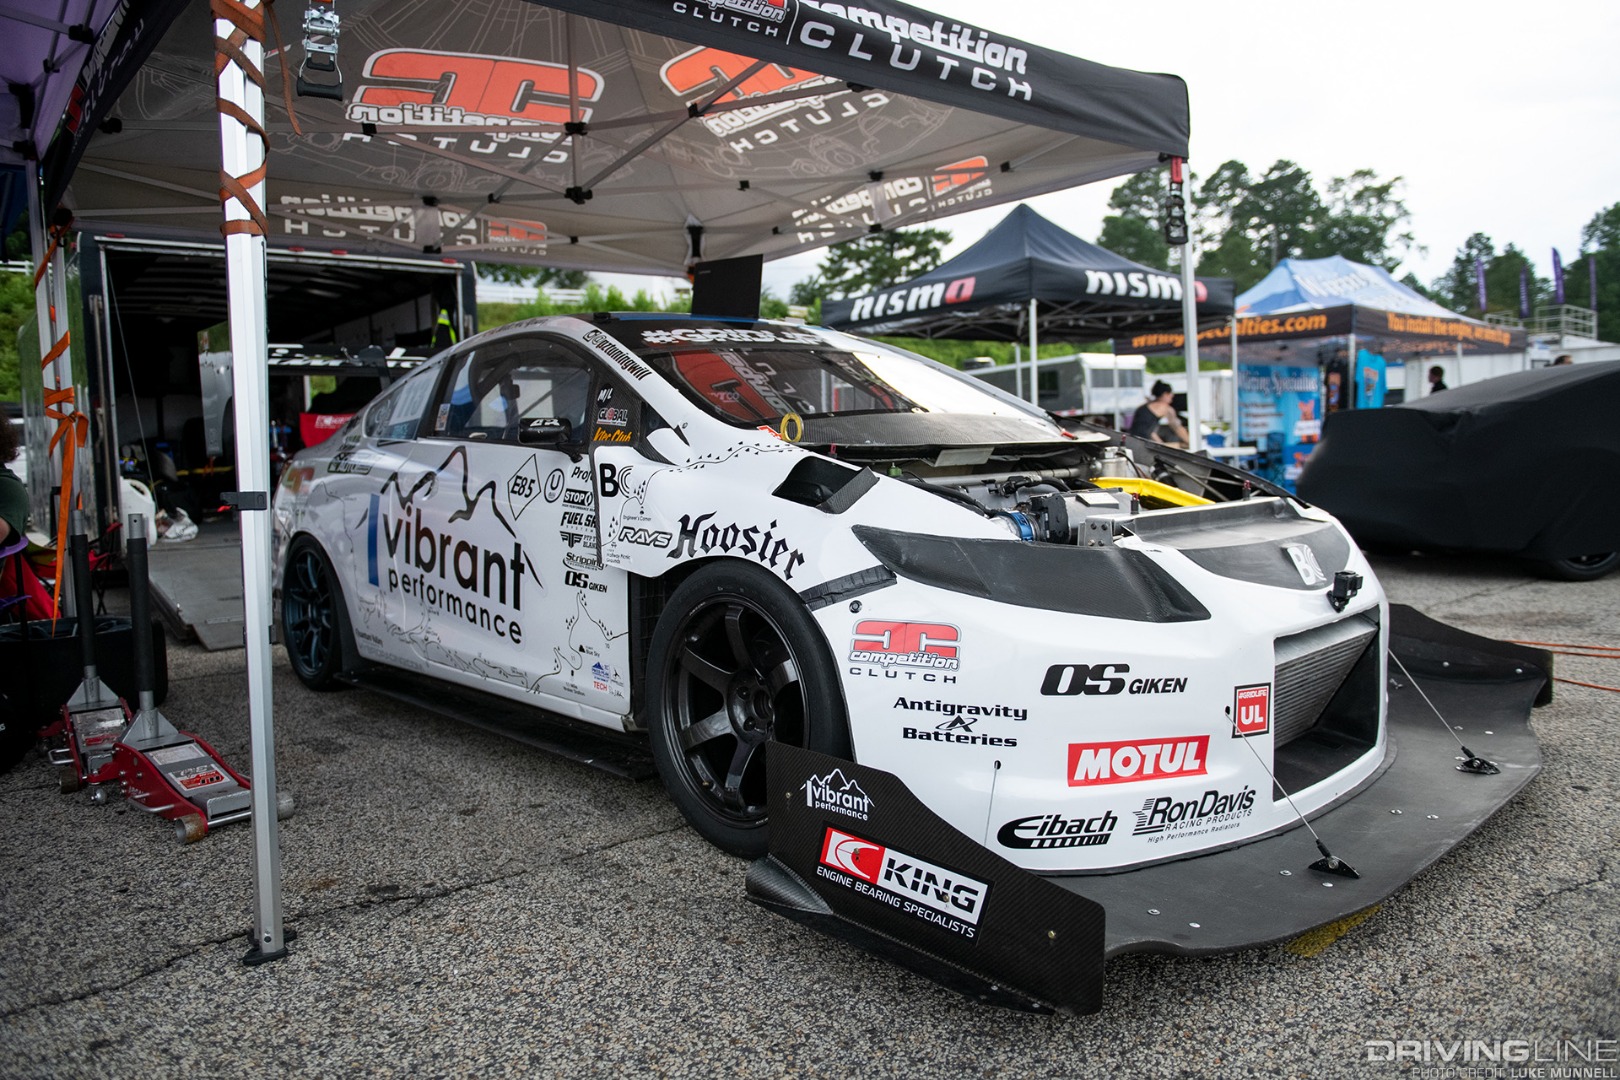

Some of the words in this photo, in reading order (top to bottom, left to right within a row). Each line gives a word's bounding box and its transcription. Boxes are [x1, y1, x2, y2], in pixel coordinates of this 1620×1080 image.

[672, 1, 779, 38] CLUTCH
[805, 0, 1028, 75] ompetition
[799, 20, 1032, 102] CLUTCH
[850, 276, 976, 322] nismo
[510, 475, 536, 498] E85
[564, 491, 585, 504] STOP
[561, 511, 583, 526] FUEL
[618, 526, 673, 548] RAYS
[667, 511, 805, 580] Hoosier
[383, 504, 525, 611] vibrant
[565, 570, 589, 589] OS
[589, 584, 607, 593] GIKEN
[389, 568, 522, 645] performance
[849, 651, 959, 671] competition
[594, 680, 608, 692] TECH
[850, 667, 957, 684] CLUTCH
[1040, 663, 1130, 696] OS
[1128, 677, 1188, 695] GIKEN
[893, 696, 1028, 721] Antigravity
[1240, 704, 1264, 725] UL
[903, 727, 1017, 747] Batteries
[1073, 741, 1200, 781] MOTUL
[812, 783, 869, 813] vibrant
[815, 800, 868, 821] performance
[997, 810, 1118, 850] Eibach
[1165, 818, 1203, 832] RACING
[1206, 808, 1253, 825] PRODUCTS
[1147, 836, 1165, 844] High
[1166, 828, 1209, 841] Performance
[1211, 822, 1241, 833] Radiators
[883, 857, 979, 914] KING
[816, 866, 852, 888] ENGINE
[854, 881, 901, 908] BEARING
[902, 901, 976, 939] SPECIALISTS
